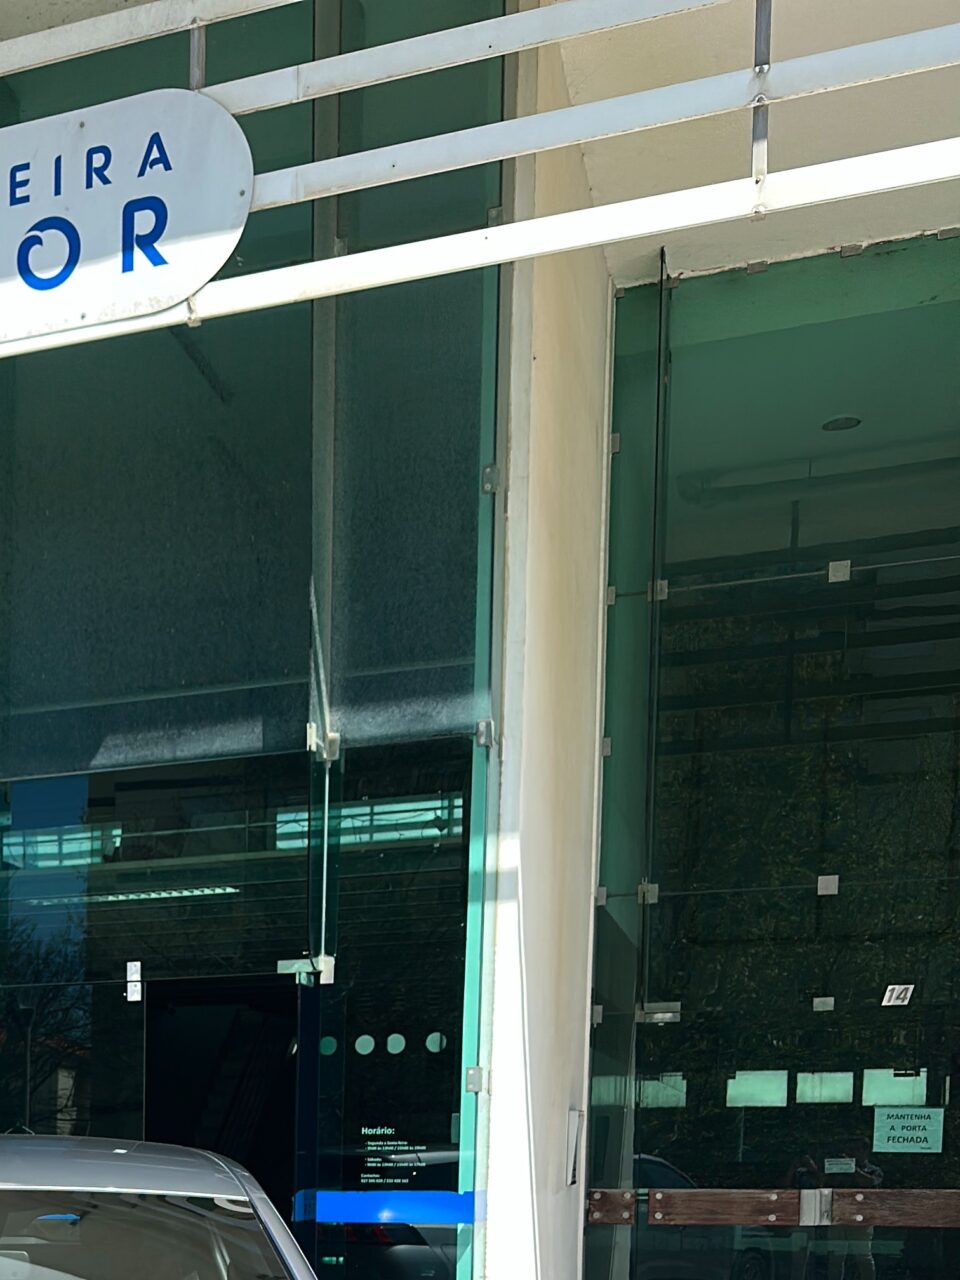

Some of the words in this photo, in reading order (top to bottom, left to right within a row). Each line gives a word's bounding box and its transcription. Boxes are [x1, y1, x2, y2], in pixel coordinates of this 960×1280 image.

[887, 986, 910, 1003] 14
[886, 1113, 931, 1121] MANTENHA
[361, 1126, 395, 1135] Horário:
[886, 1136, 929, 1144] FECHADA
